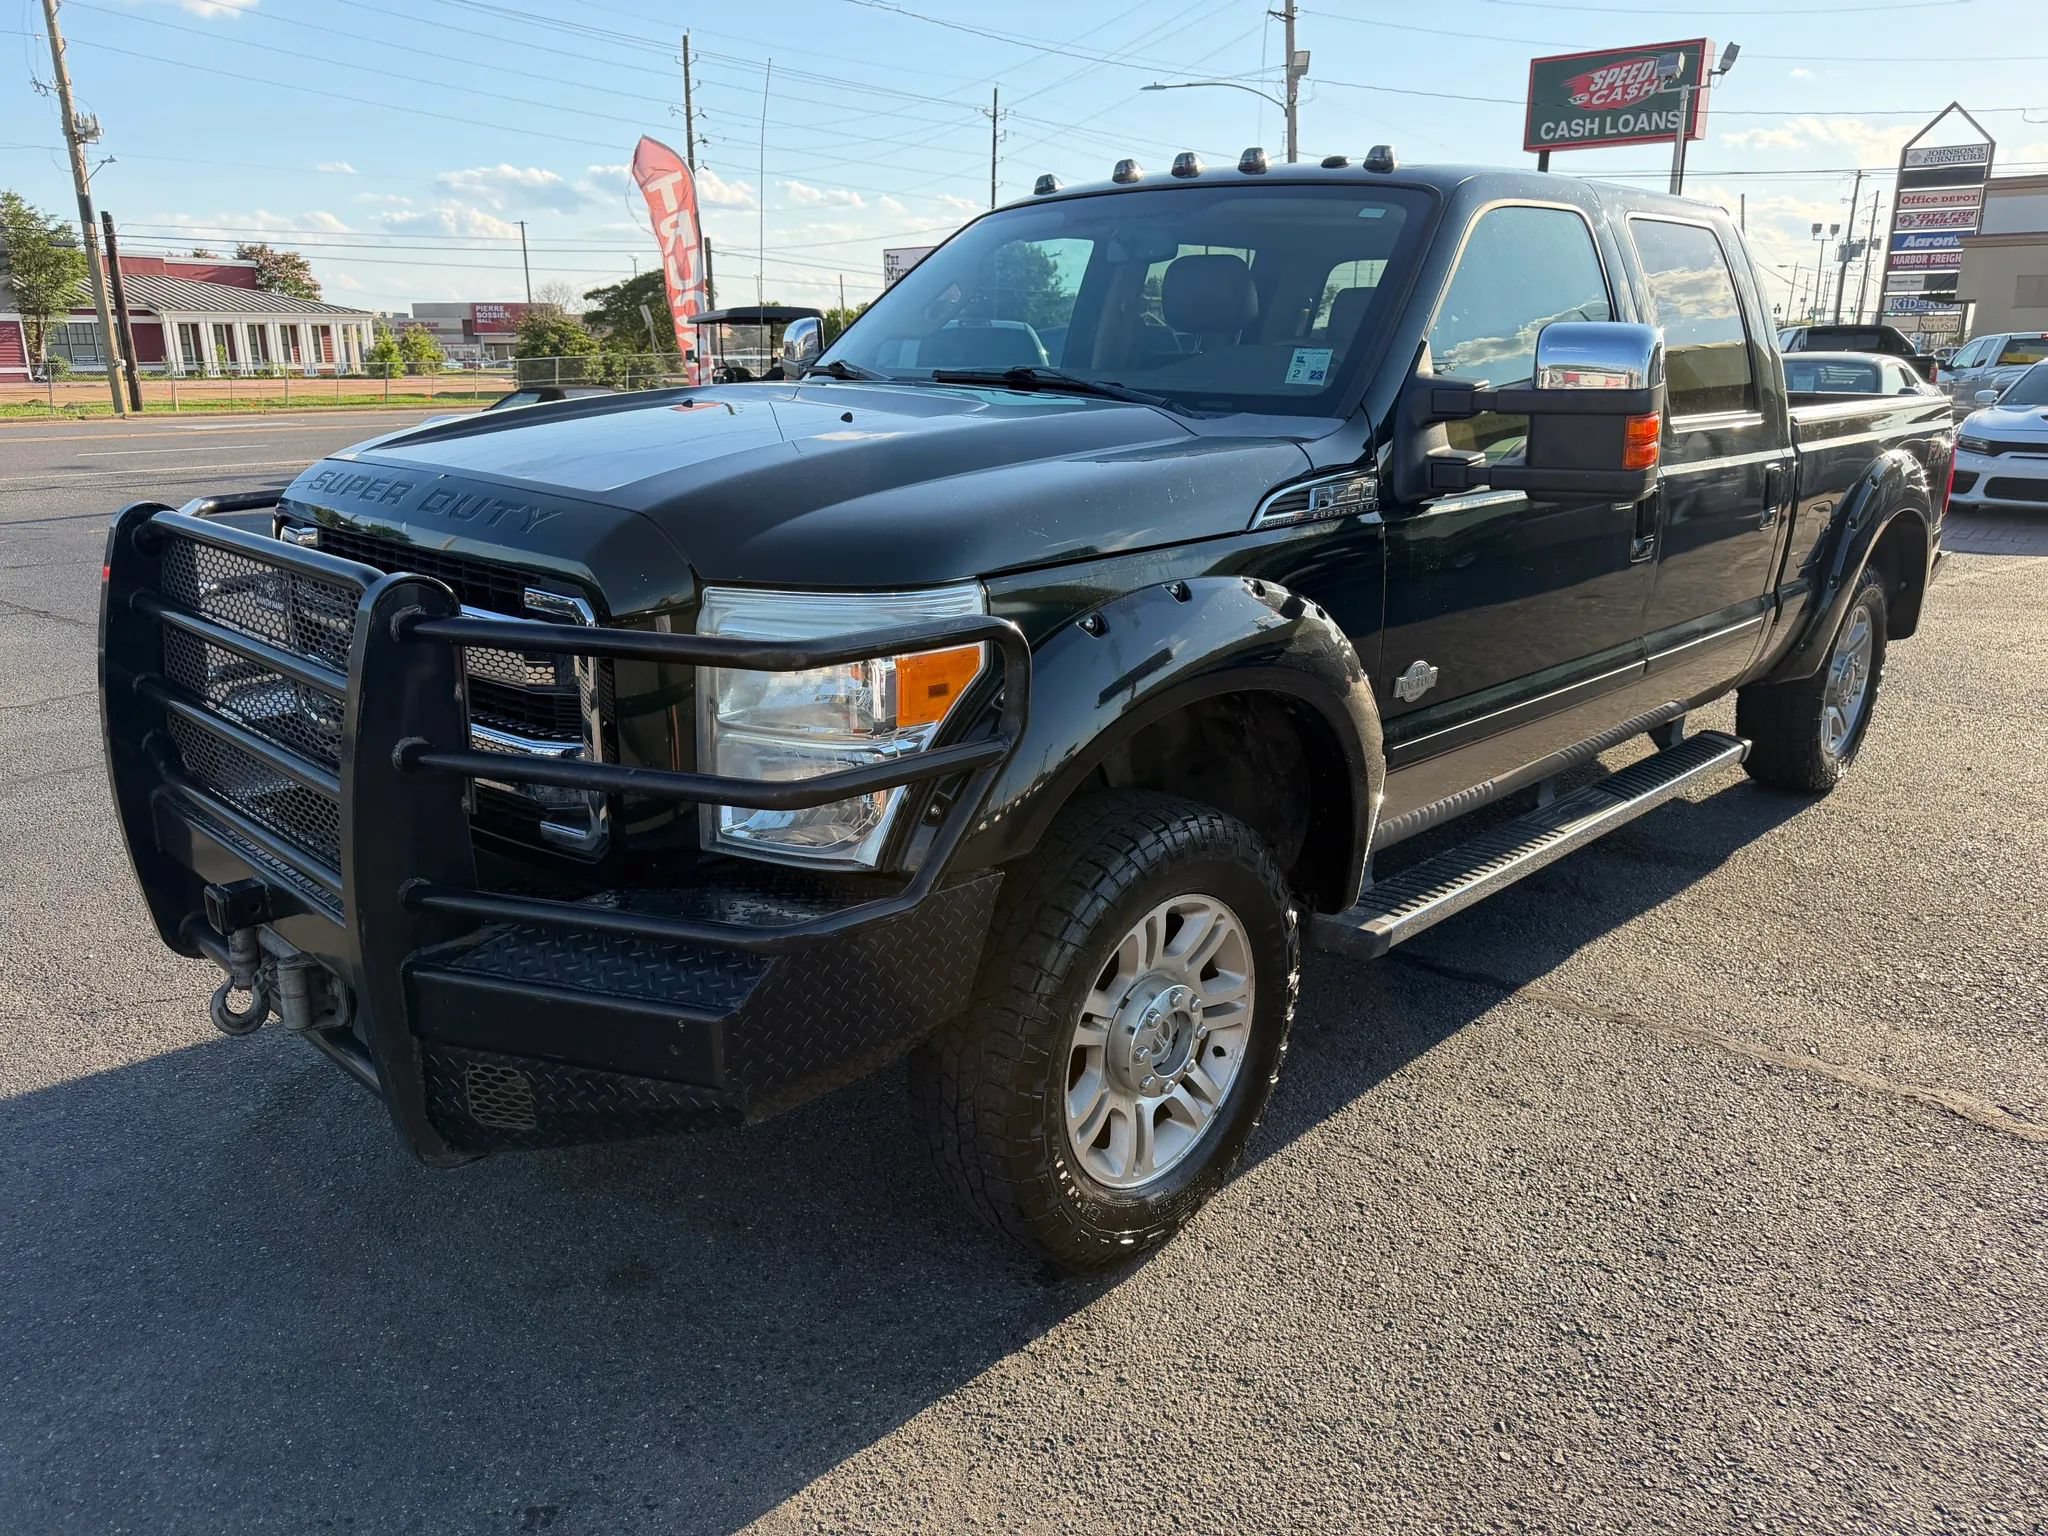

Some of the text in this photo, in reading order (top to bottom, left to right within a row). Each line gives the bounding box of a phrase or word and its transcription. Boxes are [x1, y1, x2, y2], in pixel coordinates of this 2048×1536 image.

[1540, 110, 1680, 140] CASH LOANS
[1926, 147, 1984, 157] JOHNSON'S
[1923, 153, 1985, 163] FURNITURE
[1901, 195, 1938, 204] Office
[1919, 217, 1969, 225] TRUCKS
[1902, 235, 1960, 247] Aaron's
[1893, 255, 1927, 264] HARBOR
[1292, 369, 1324, 380] 2 23
[308, 469, 564, 535] SUPER DUTY
